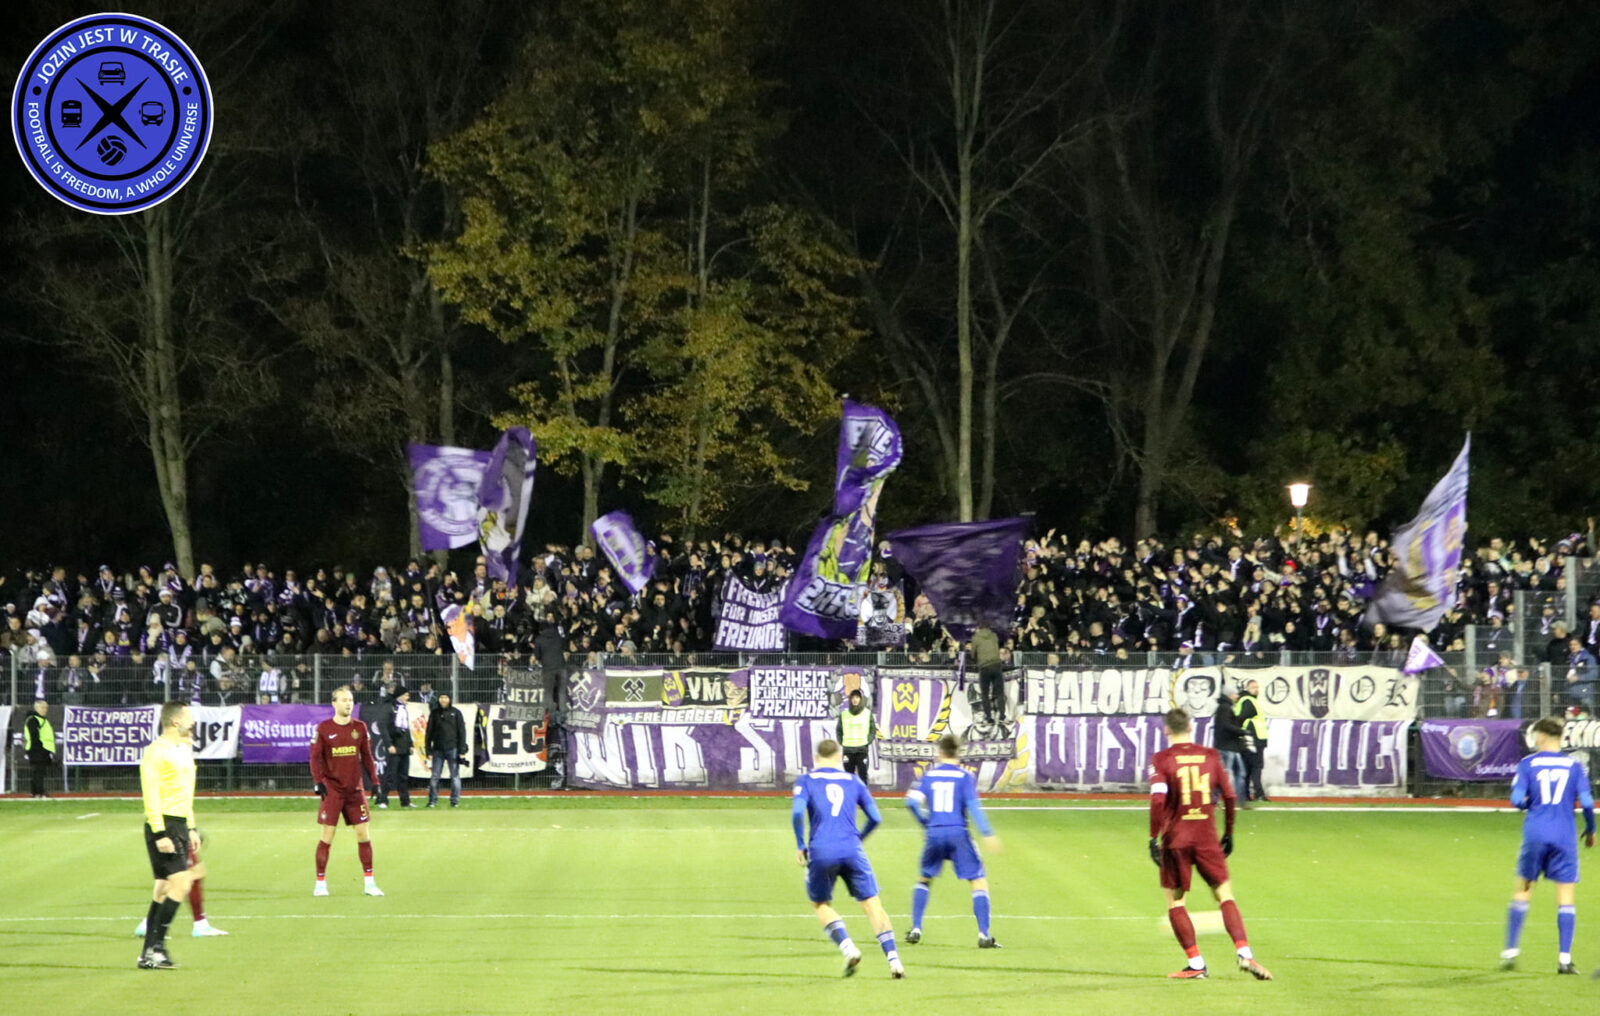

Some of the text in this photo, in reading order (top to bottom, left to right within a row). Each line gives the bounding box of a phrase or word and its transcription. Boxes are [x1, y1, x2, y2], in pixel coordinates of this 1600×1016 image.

[753, 669, 829, 688] FREIHEIT
[507, 688, 544, 703] JETZT
[781, 687, 828, 701] UNSERE
[752, 700, 829, 717] FREUNDE
[891, 724, 917, 738] AUE
[1176, 765, 1211, 806] 14
[1536, 768, 1570, 805] 17
[825, 783, 845, 817] 9
[930, 781, 956, 813] 11
